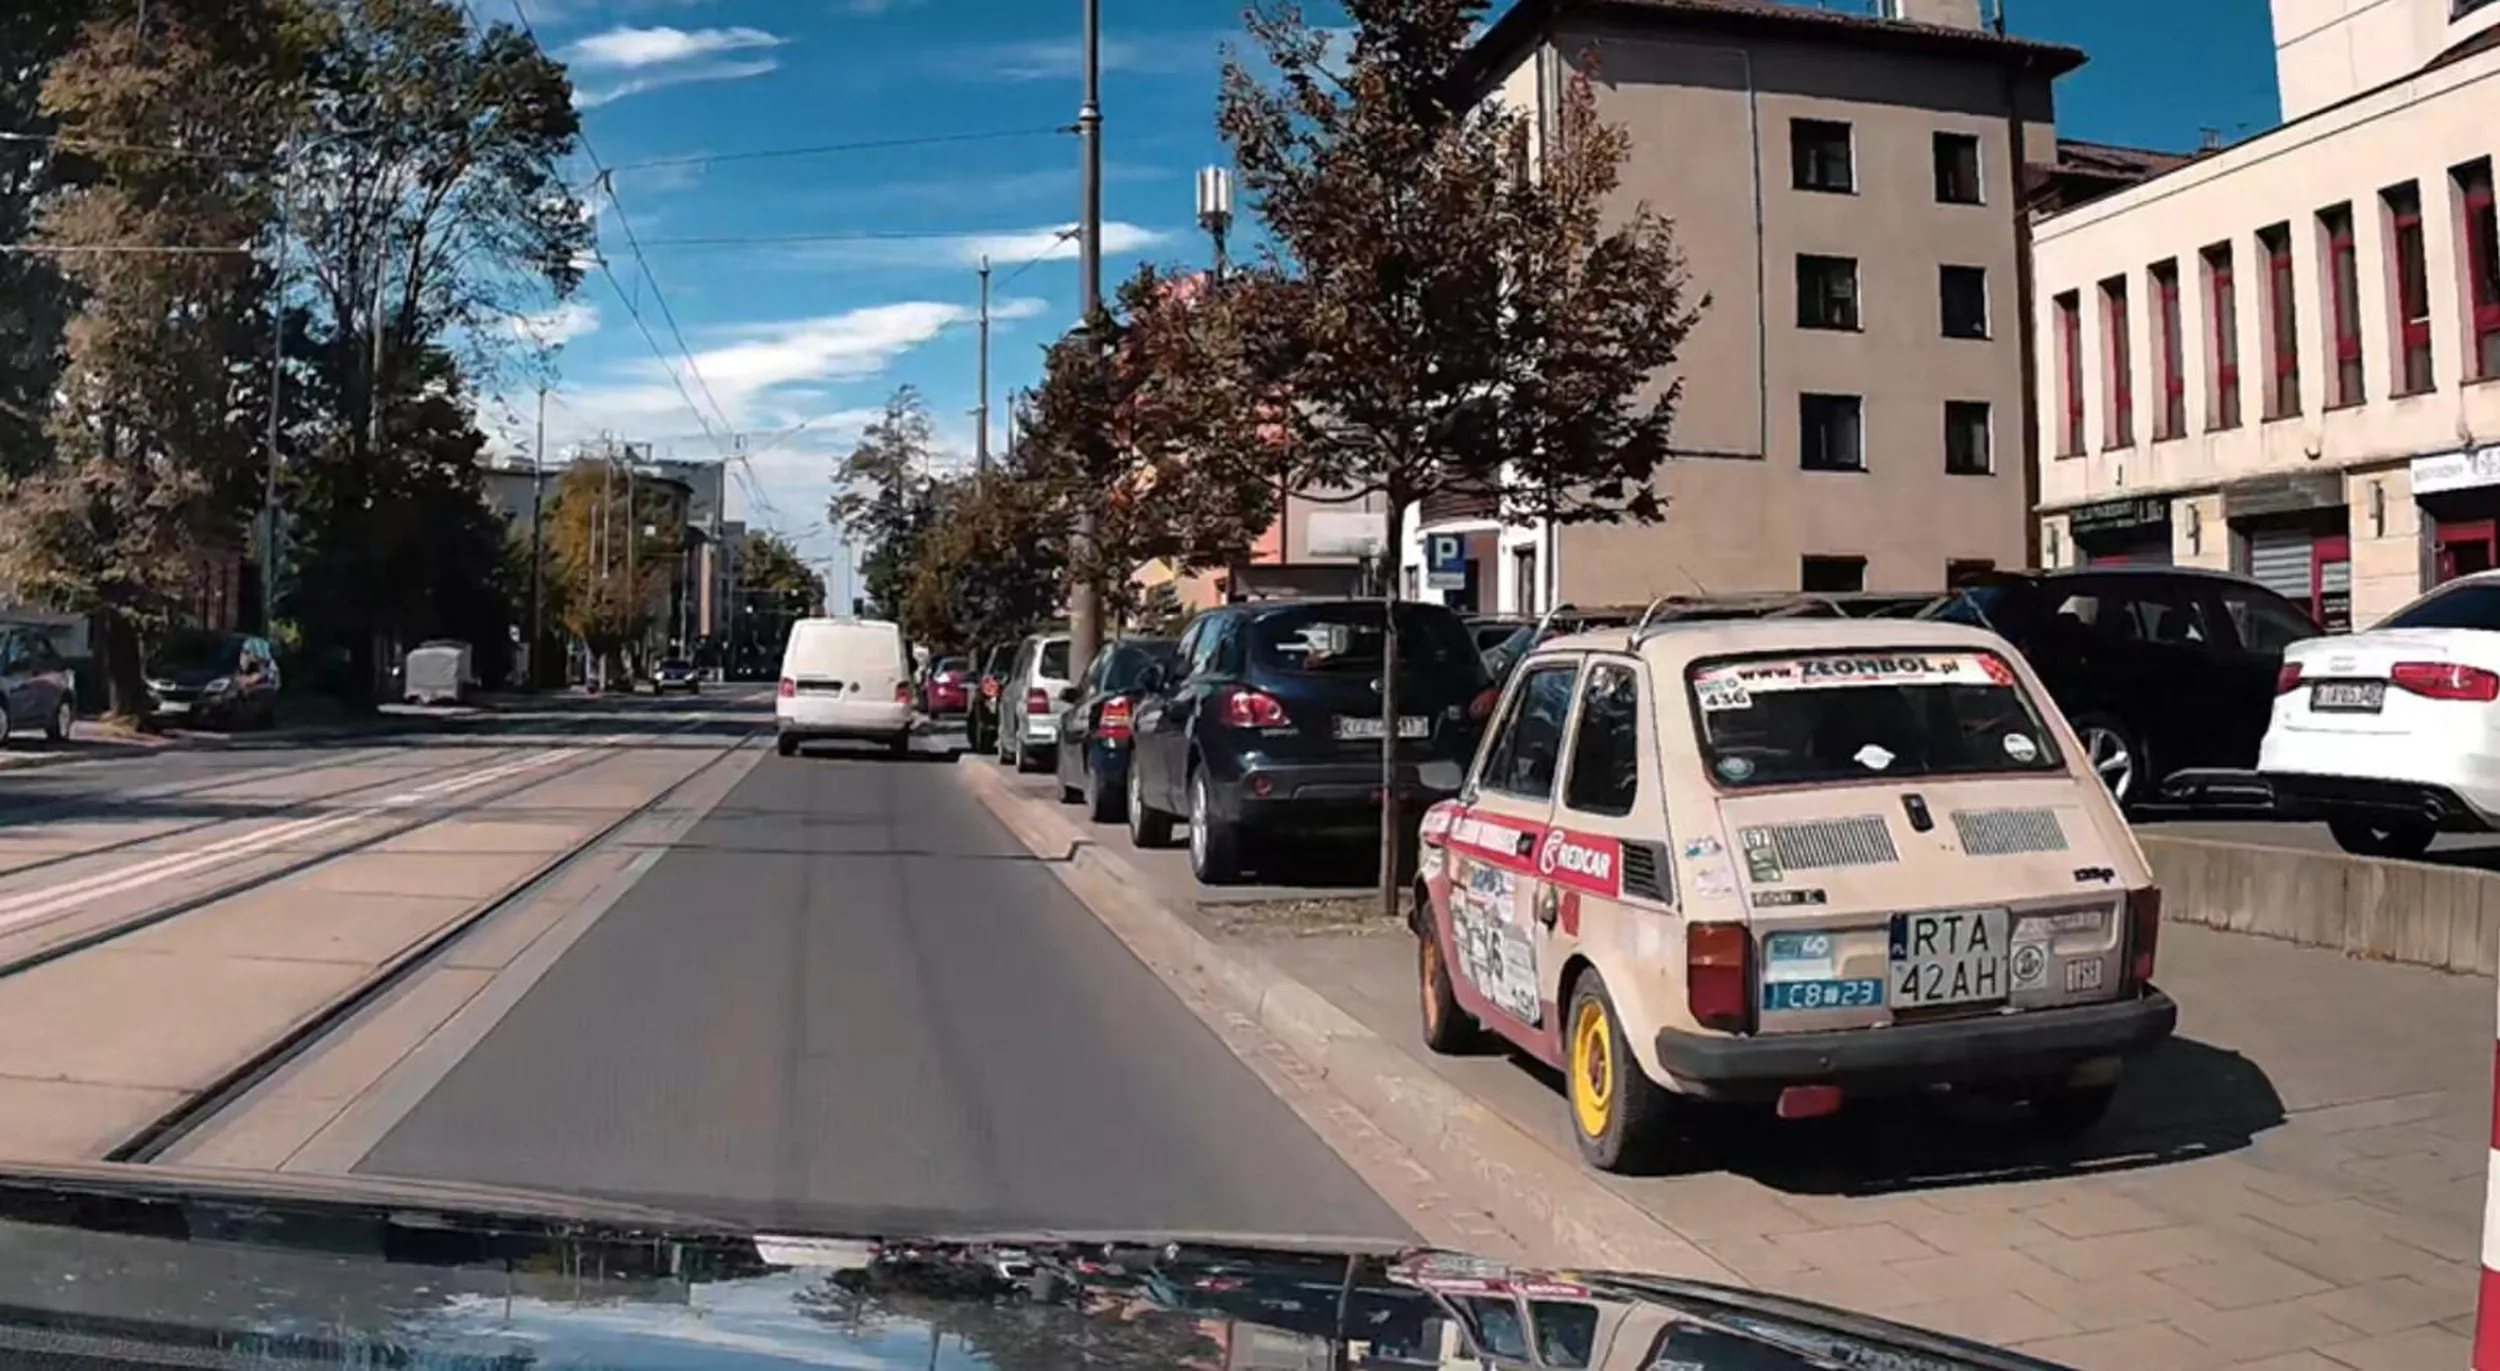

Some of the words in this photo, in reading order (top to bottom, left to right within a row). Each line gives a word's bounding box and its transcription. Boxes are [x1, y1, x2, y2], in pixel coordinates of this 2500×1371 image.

[1435, 537, 1458, 567] P
[1558, 843, 1611, 880] REDCAR
[1914, 913, 1989, 956] RTA
[1900, 957, 1997, 1002] 42AH
